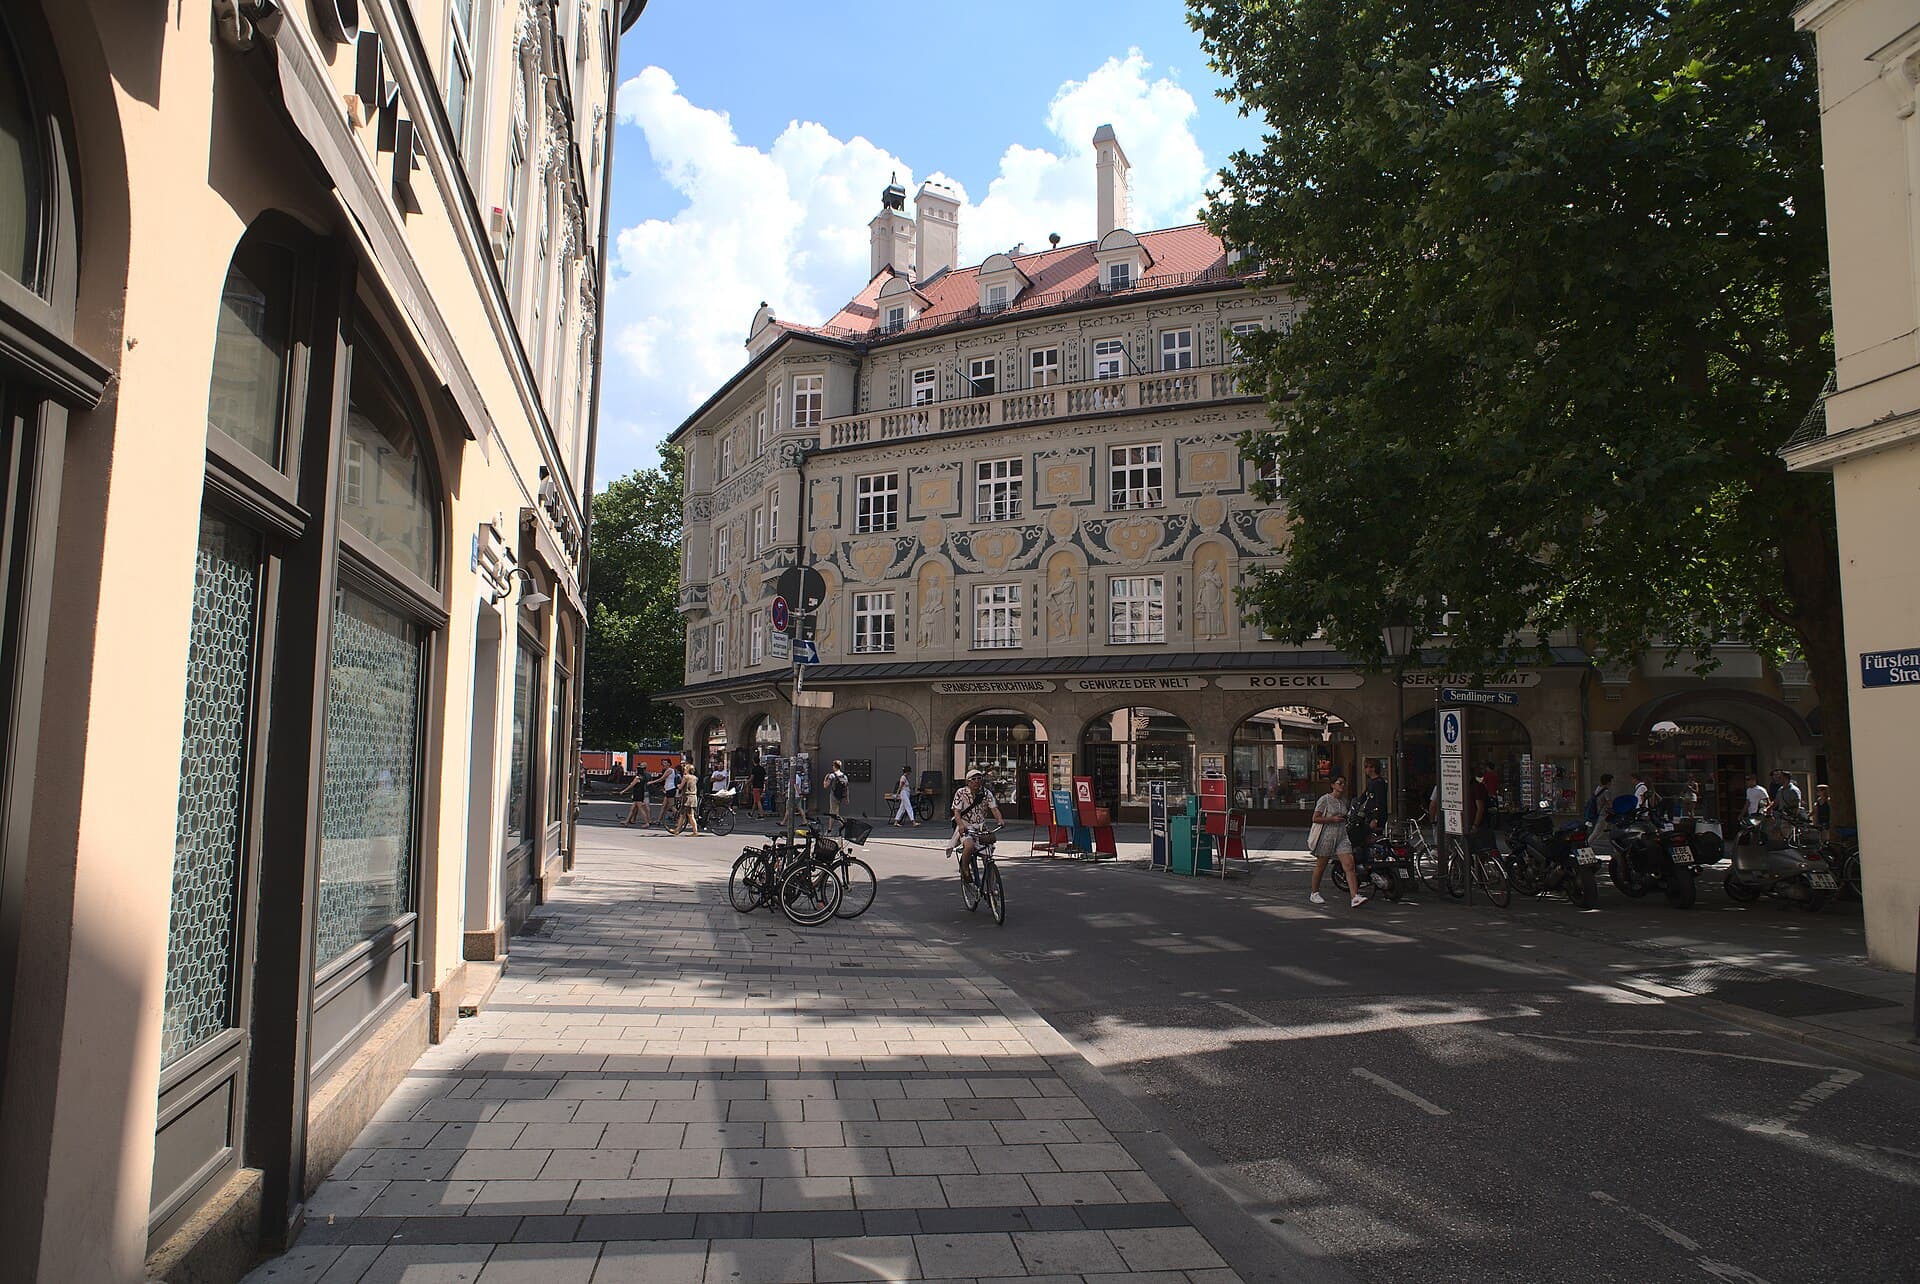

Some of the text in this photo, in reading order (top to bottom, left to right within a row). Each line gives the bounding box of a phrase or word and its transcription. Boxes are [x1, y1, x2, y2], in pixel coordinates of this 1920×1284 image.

[1865, 653, 1920, 670] Fürsten
[942, 681, 1044, 692] SPANISCHES FRUCHTHAUS
[1134, 678, 1157, 689] DER
[1159, 678, 1189, 688] WELT
[1250, 676, 1330, 687] ROECKL
[1450, 690, 1513, 704] Sendlinger Str.
[1445, 744, 1457, 753] ZONE
